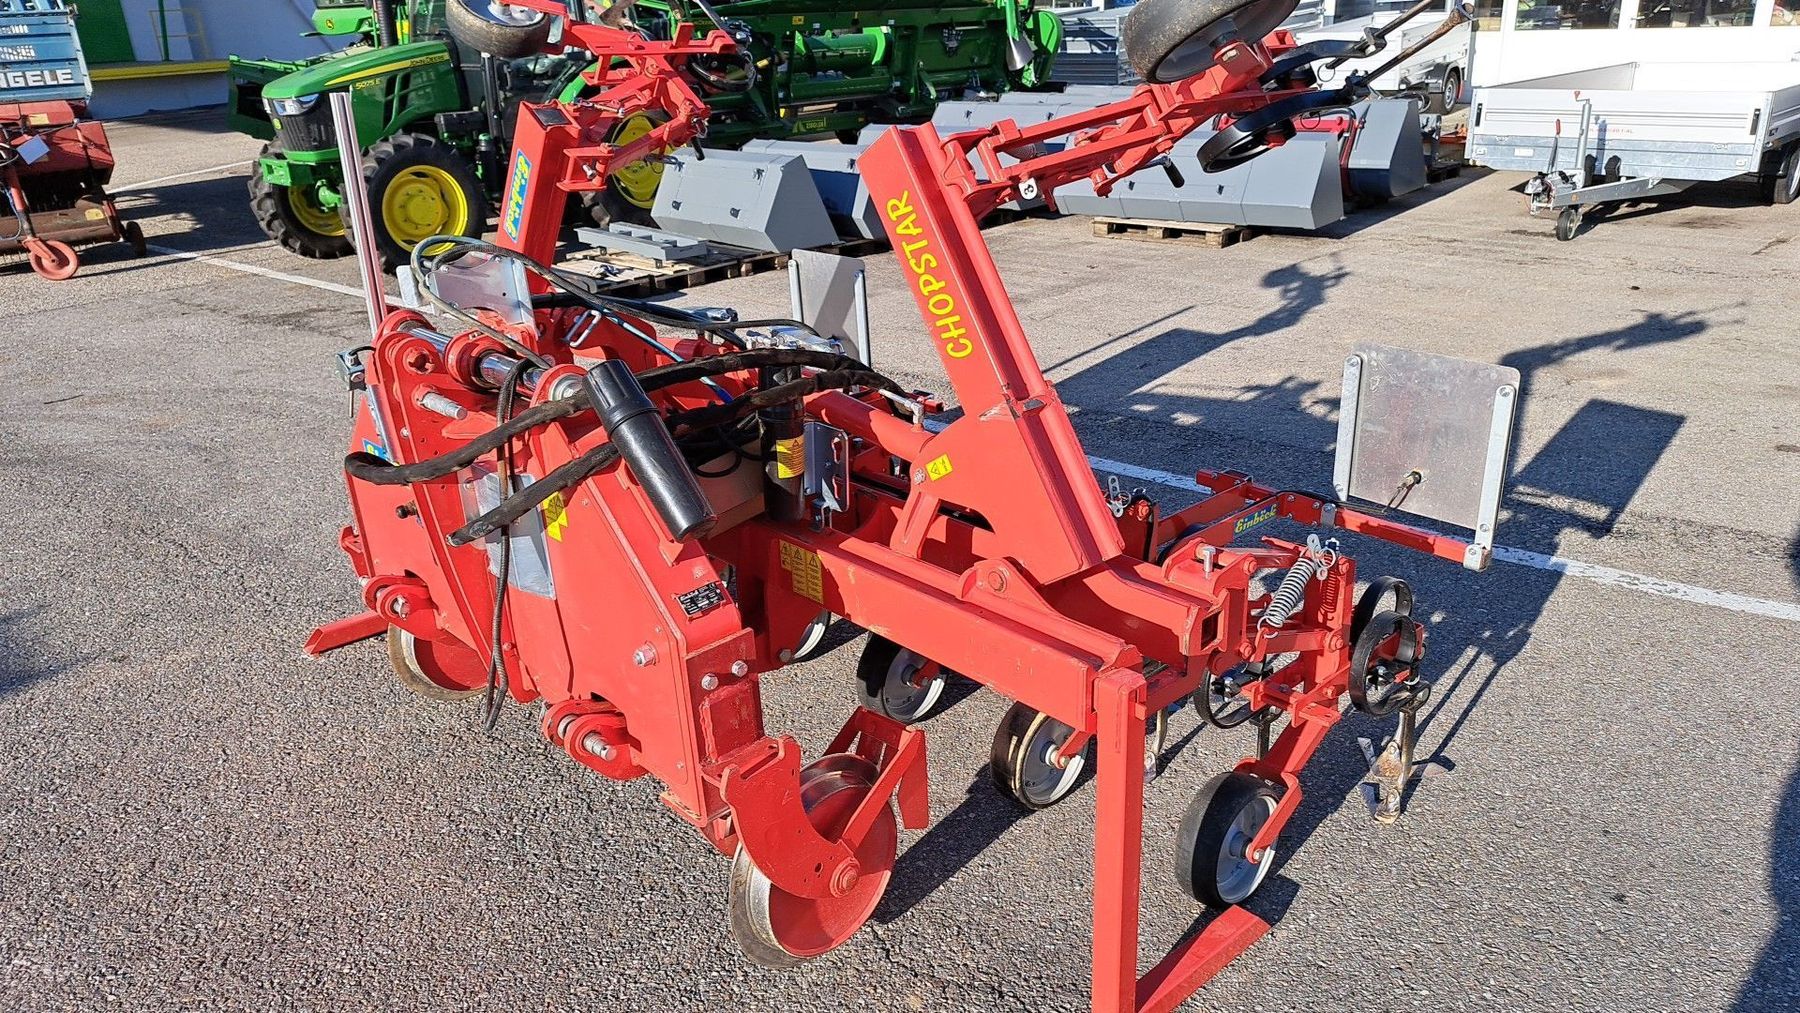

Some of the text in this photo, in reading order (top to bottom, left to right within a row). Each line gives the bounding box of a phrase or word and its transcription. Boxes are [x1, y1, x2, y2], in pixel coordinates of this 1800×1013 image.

[1023, 183, 1035, 195] 3
[886, 189, 973, 359] CHOPSTAR
[1234, 503, 1277, 533] Einböck
